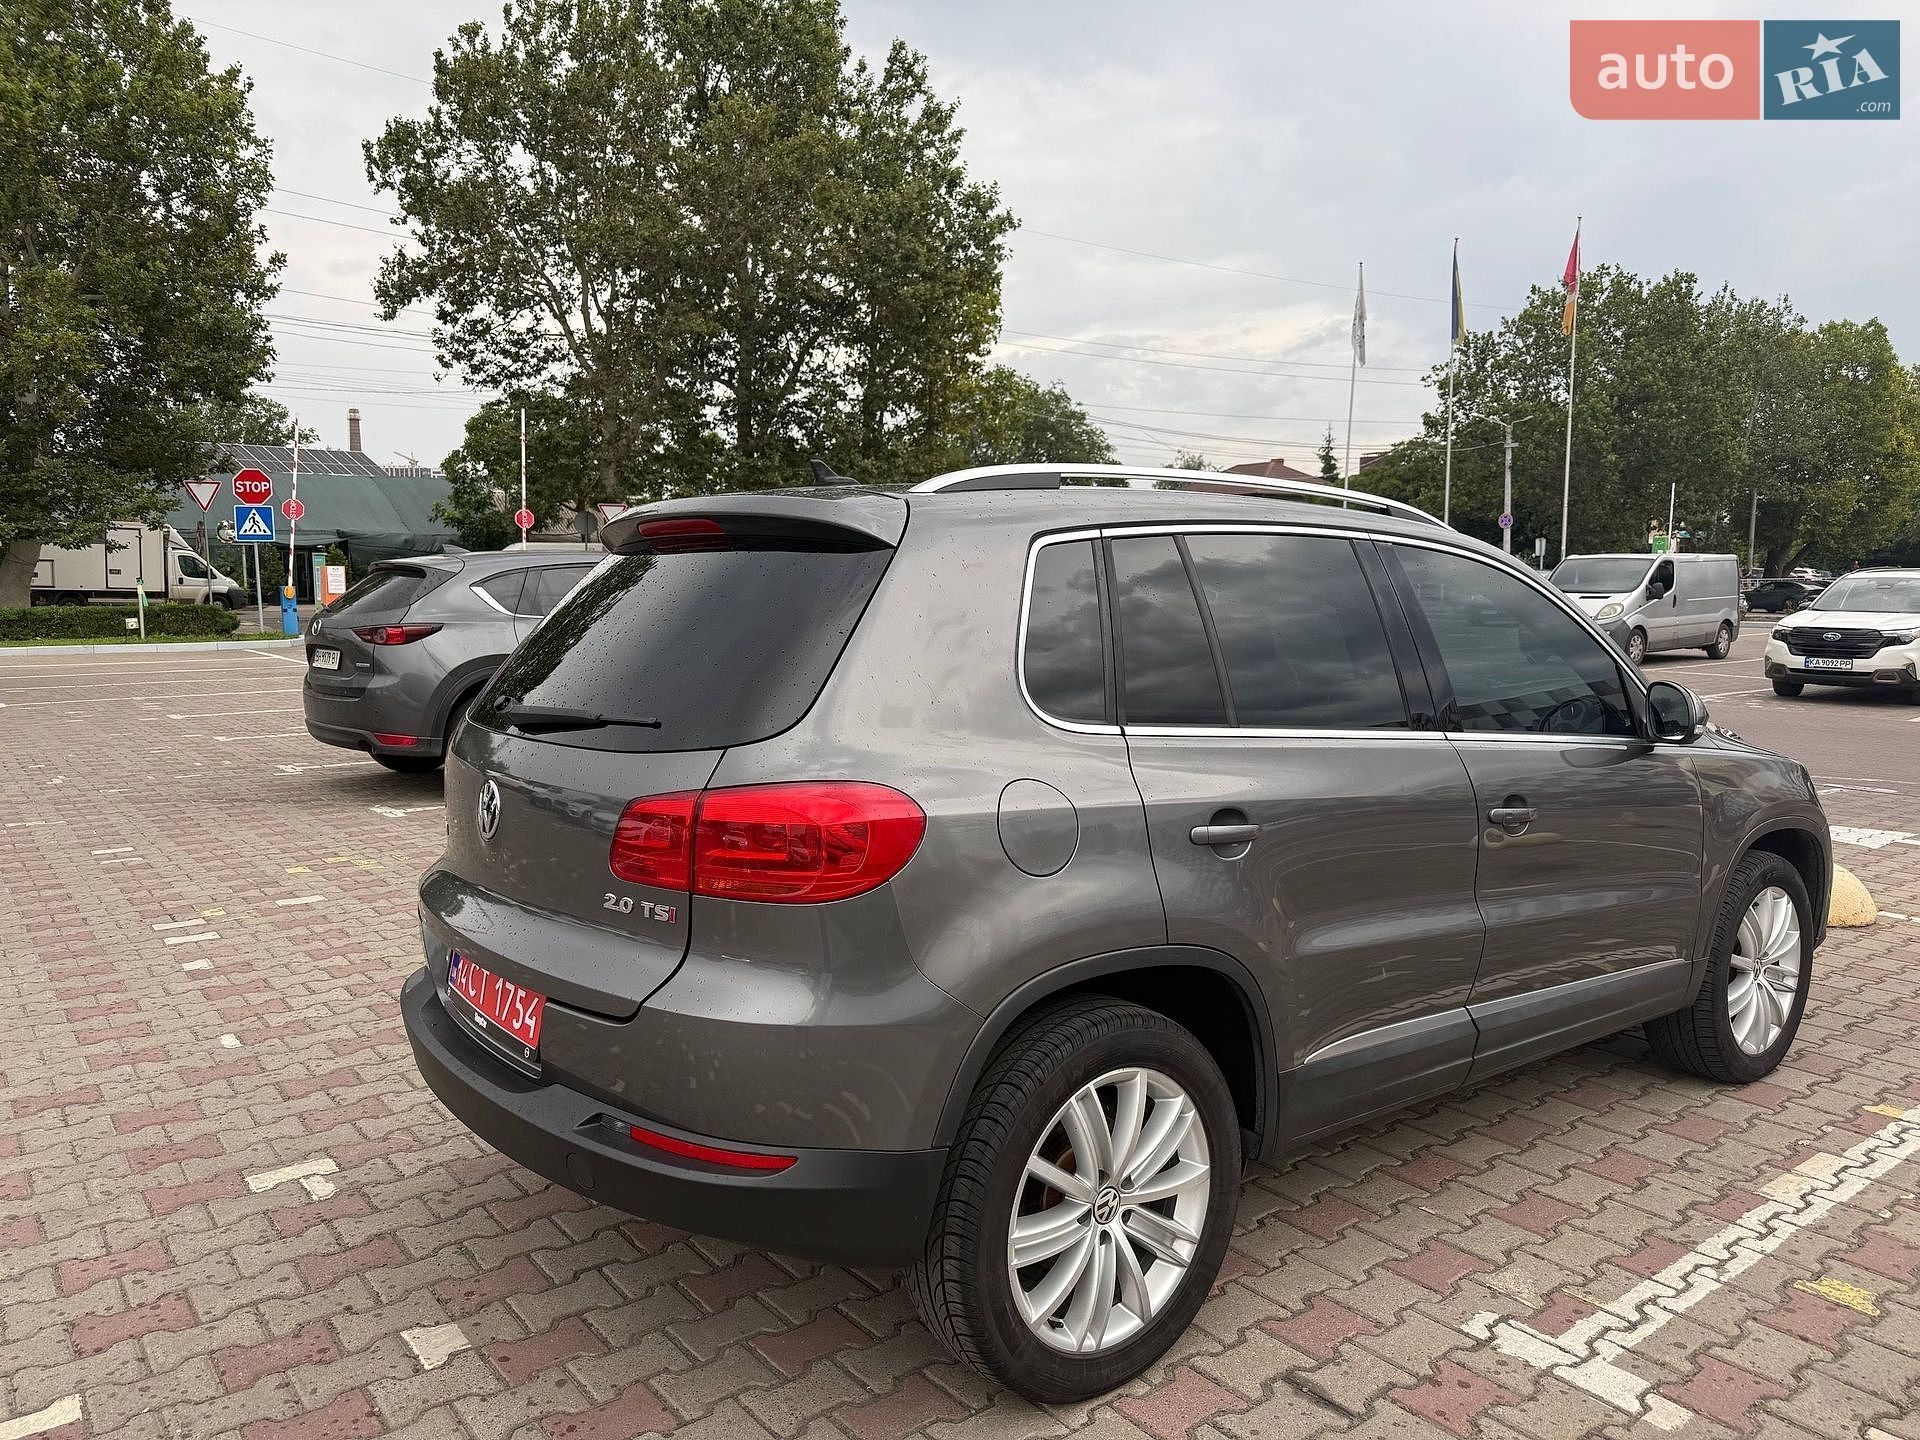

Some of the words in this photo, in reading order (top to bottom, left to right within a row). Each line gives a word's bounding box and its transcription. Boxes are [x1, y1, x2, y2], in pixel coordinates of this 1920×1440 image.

[235, 481, 270, 493] STOP
[289, 500, 297, 518] STOP
[1809, 658, 1821, 666] KA
[1821, 659, 1839, 667] 9092
[1839, 660, 1851, 668] PP
[641, 900, 677, 924] TSI
[495, 977, 539, 1039] 1754
